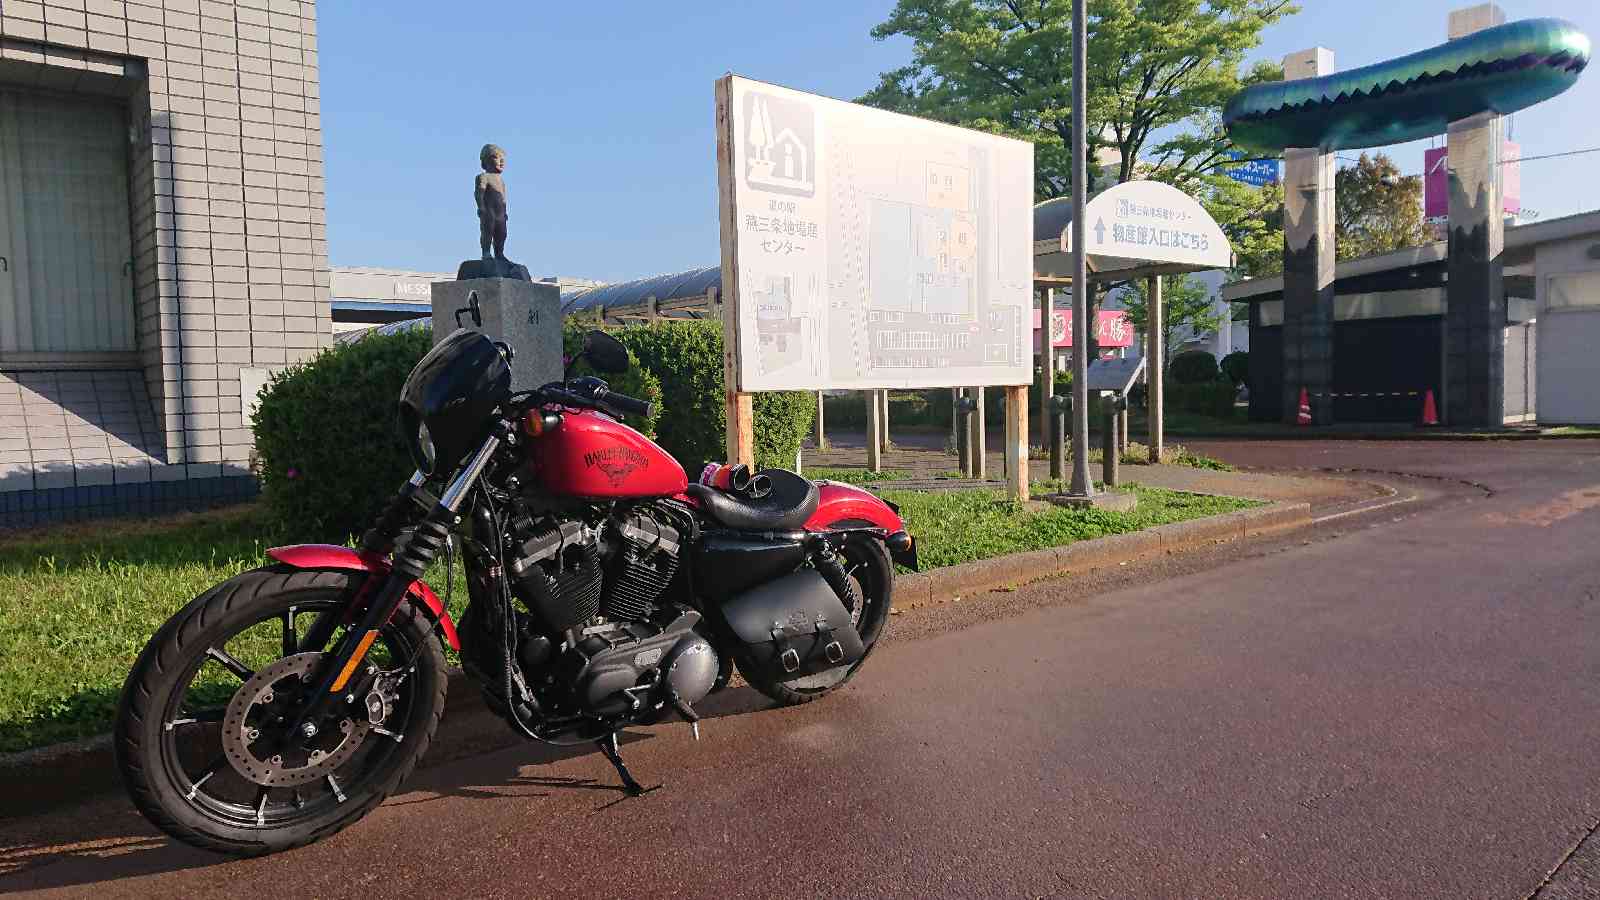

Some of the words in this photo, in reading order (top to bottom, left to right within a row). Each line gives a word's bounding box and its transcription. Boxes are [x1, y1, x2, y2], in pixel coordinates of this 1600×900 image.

[745, 215, 817, 238] 燕三条地場産
[1112, 223, 1209, 250] 物産館入口はこちら
[760, 239, 806, 255] センター
